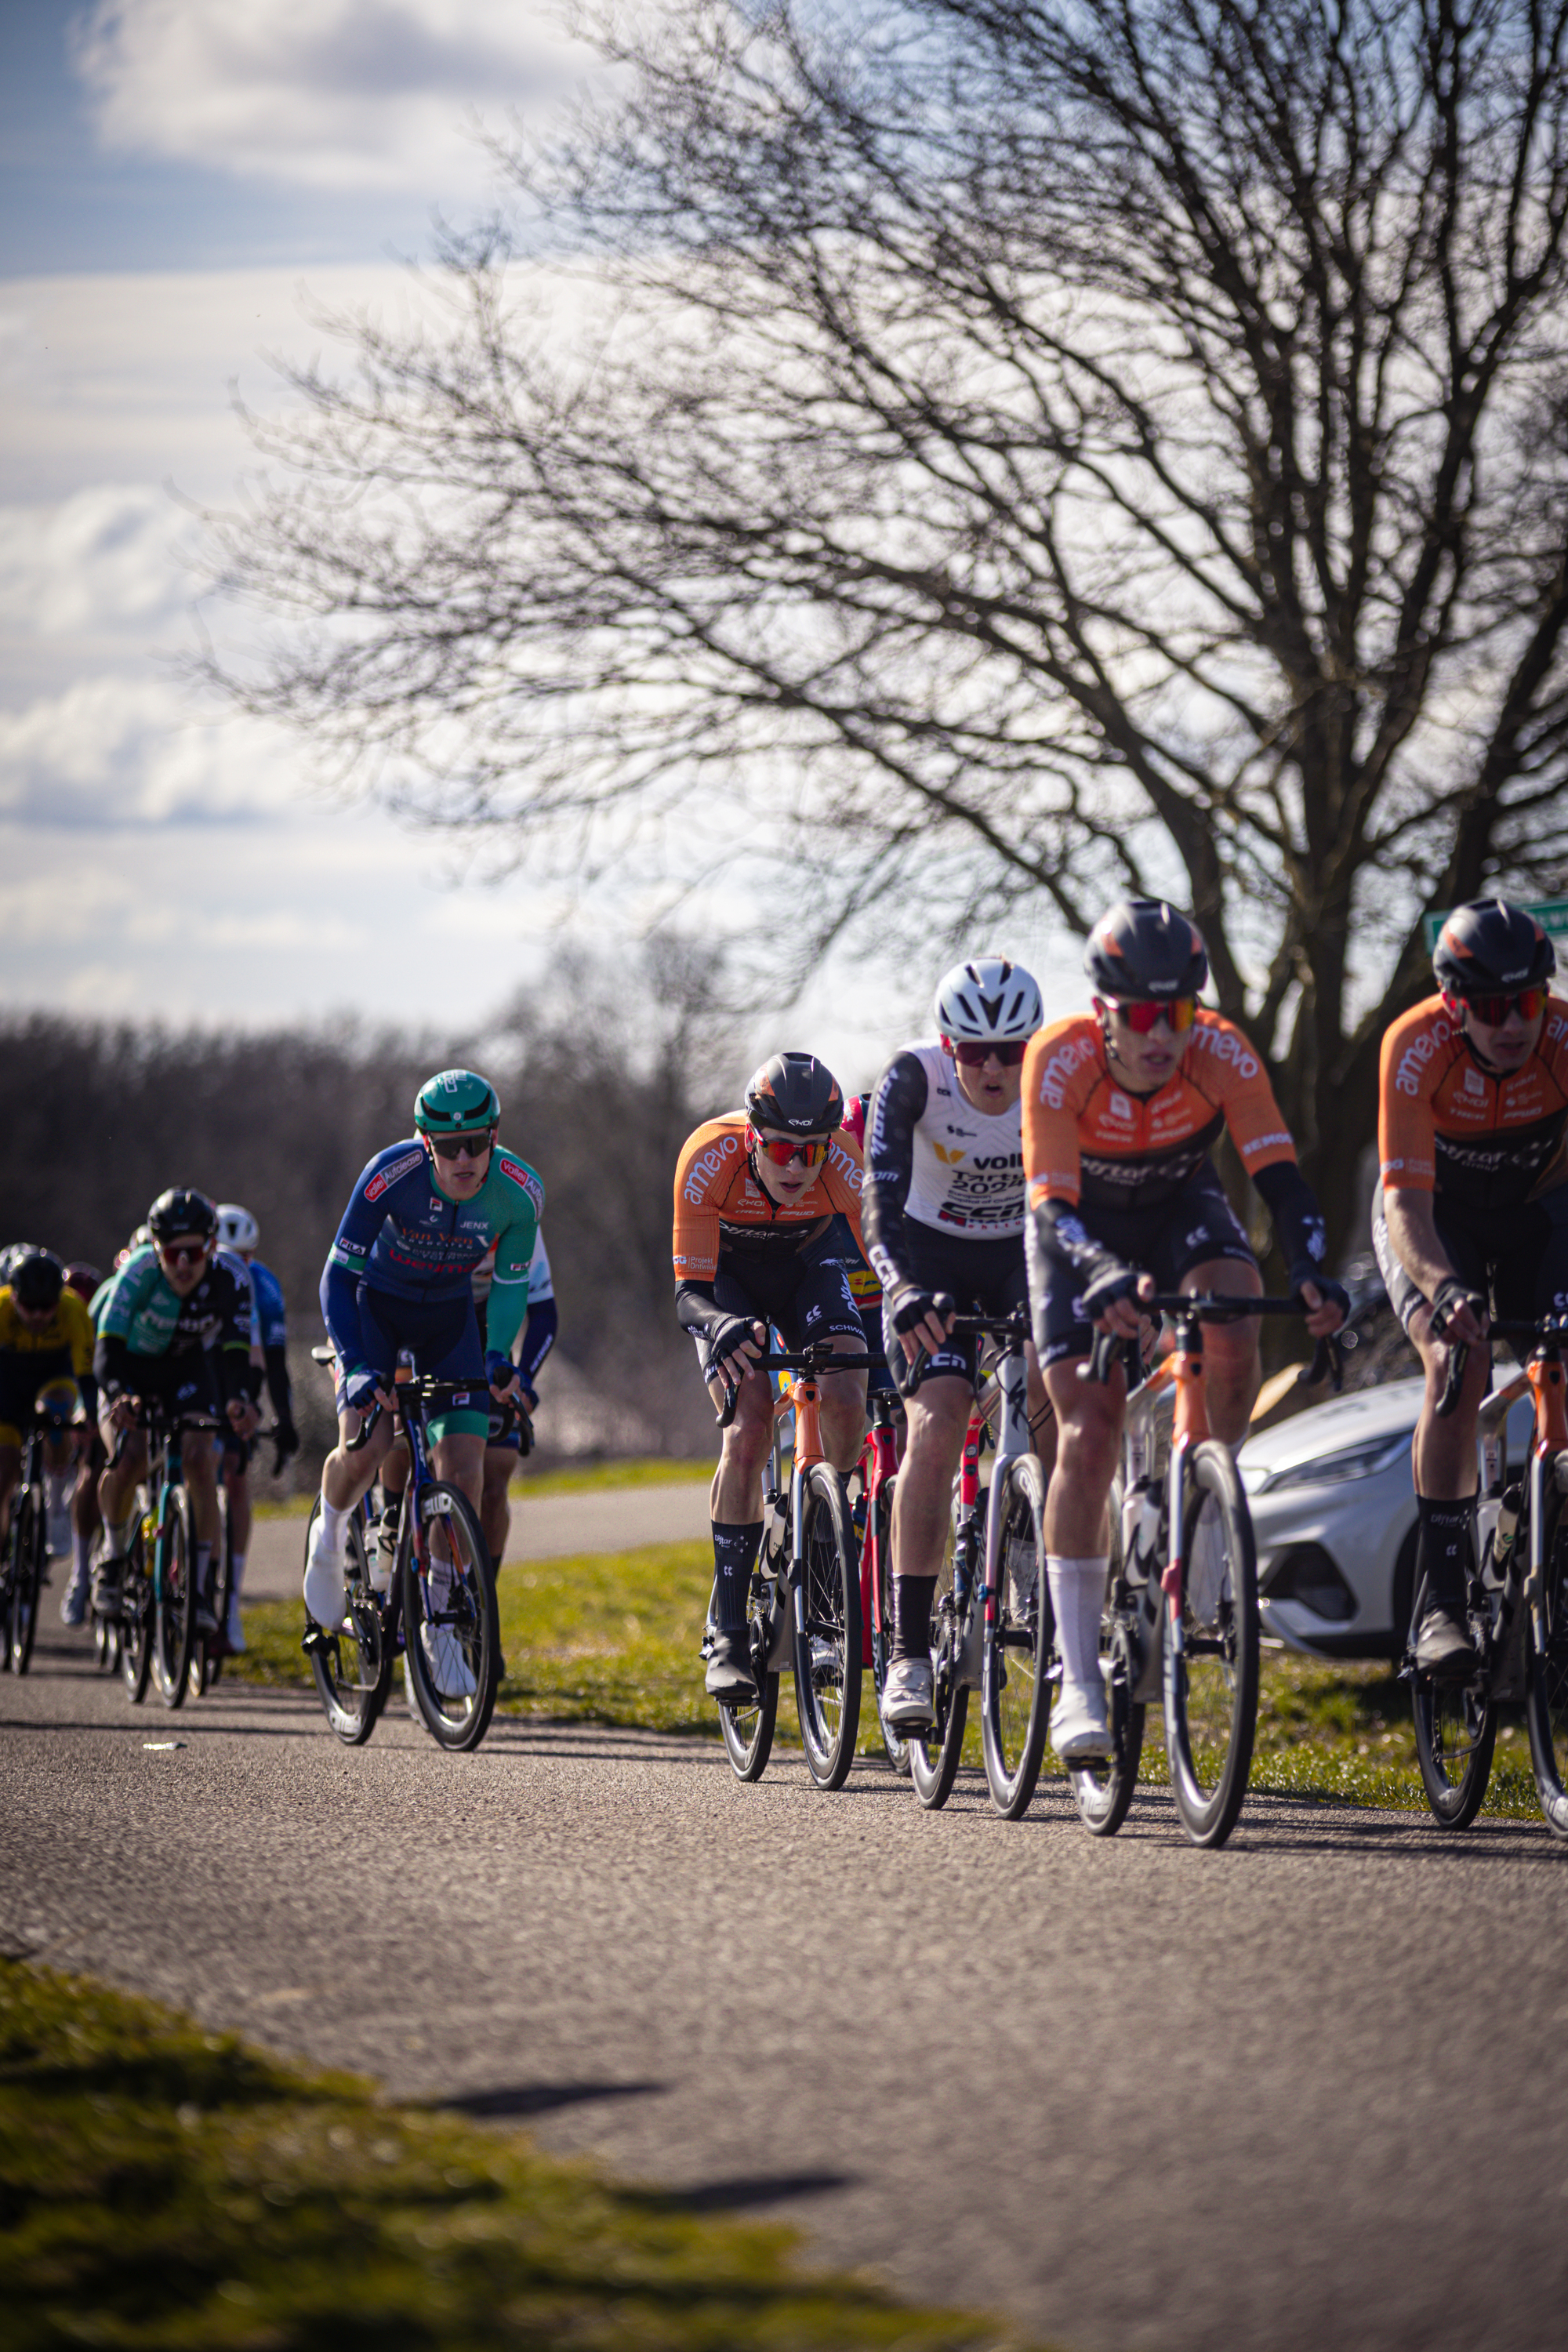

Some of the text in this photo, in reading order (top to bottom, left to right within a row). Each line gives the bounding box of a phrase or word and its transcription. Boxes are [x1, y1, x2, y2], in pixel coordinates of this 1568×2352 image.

[1192, 1024, 1258, 1079] mevo
[1396, 1021, 1450, 1096] amevo
[383, 1154, 421, 1182] Autolease
[503, 1160, 527, 1183] Vallei
[684, 1136, 739, 1205] amevo
[366, 1177, 385, 1197] Vallei
[460, 1221, 488, 1230] JENX
[341, 1240, 363, 1253] FILA
